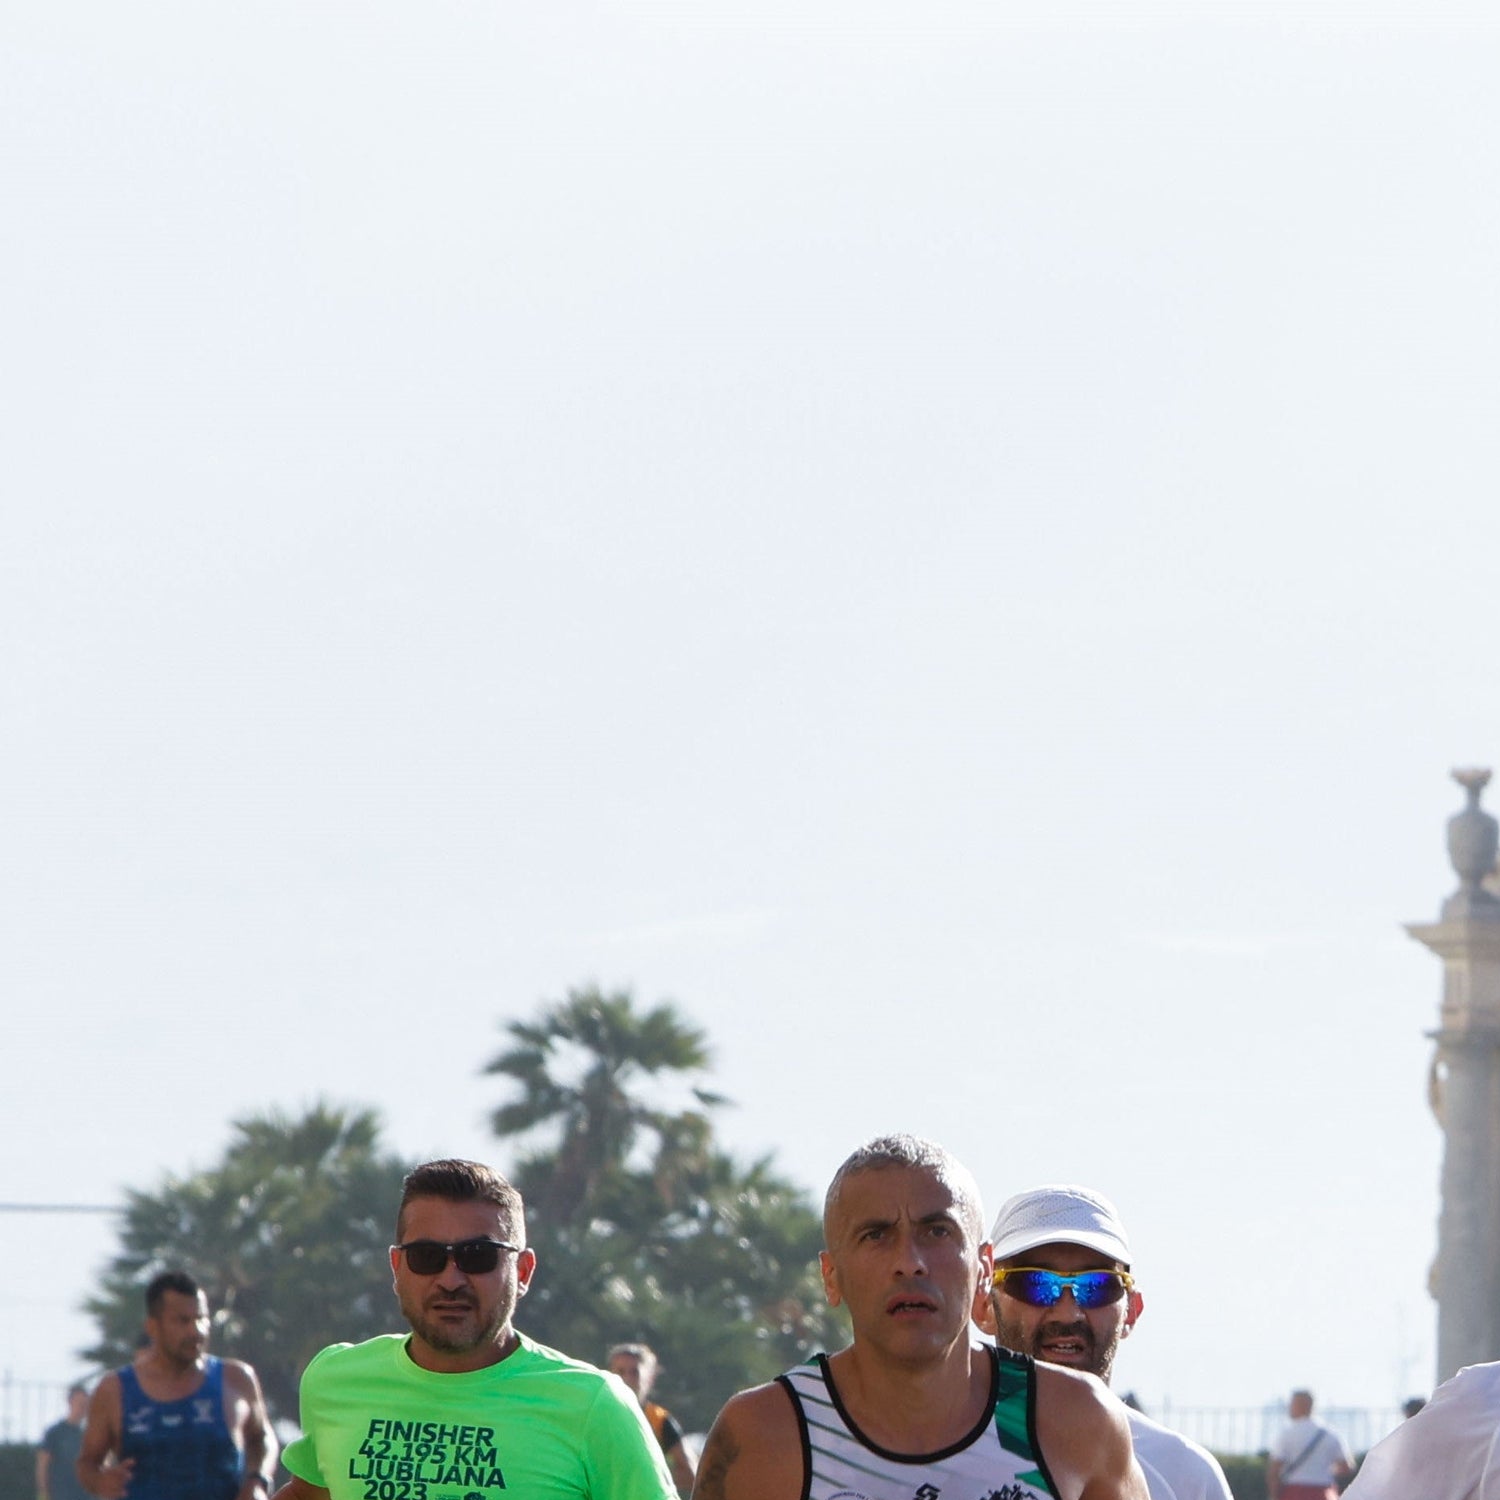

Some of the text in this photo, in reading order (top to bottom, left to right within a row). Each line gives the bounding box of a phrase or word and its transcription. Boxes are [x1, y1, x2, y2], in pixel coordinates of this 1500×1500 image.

[368, 1419, 494, 1447] FINISHER
[358, 1438, 497, 1467] 42.195 KM
[349, 1458, 506, 1489] LJUBLJANA
